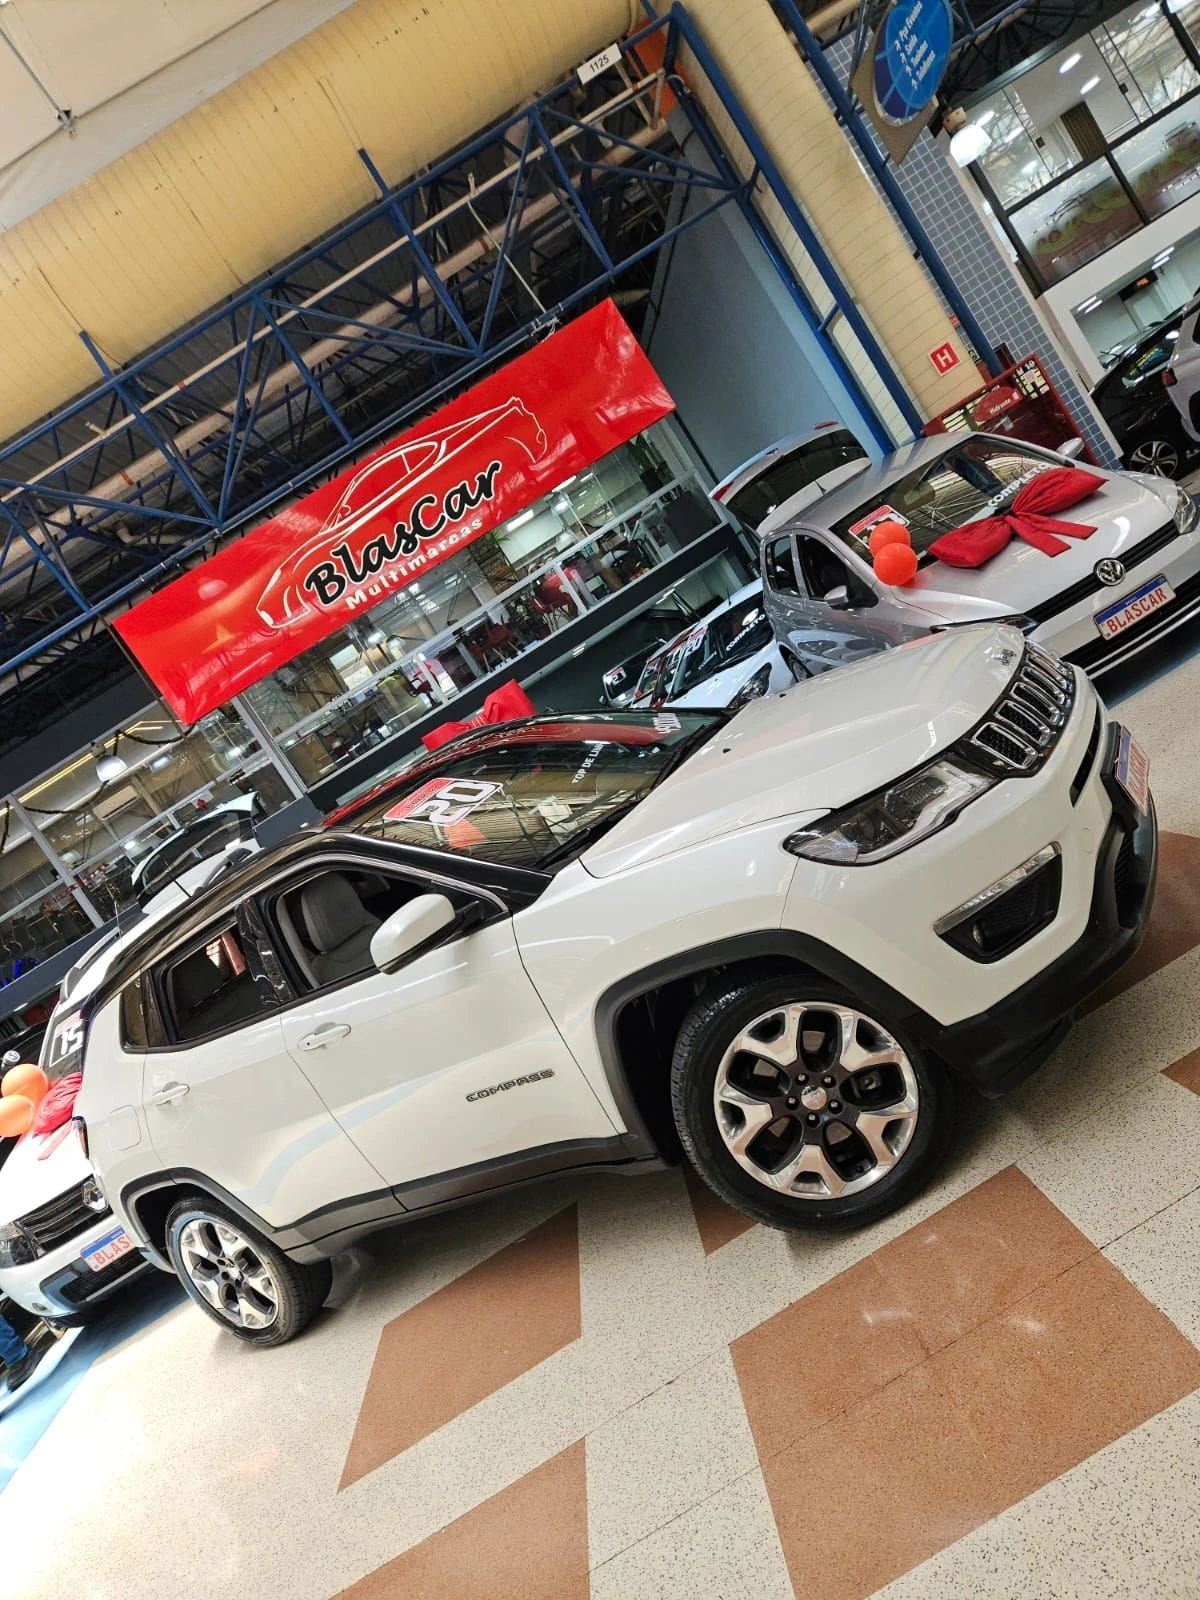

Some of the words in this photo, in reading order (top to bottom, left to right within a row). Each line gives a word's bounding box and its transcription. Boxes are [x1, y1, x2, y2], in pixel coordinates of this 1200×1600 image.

[590, 54, 609, 72] 1125
[987, 462, 1049, 507] COMPLETO
[303, 461, 502, 606] BlasCar
[345, 517, 484, 610] Multimarcas
[1107, 587, 1167, 633] BLASCAR
[571, 768, 587, 784] TOP
[581, 757, 595, 768] DE
[410, 781, 496, 824] 20
[61, 1019, 84, 1056] 15
[466, 1068, 555, 1102] COMPASS
